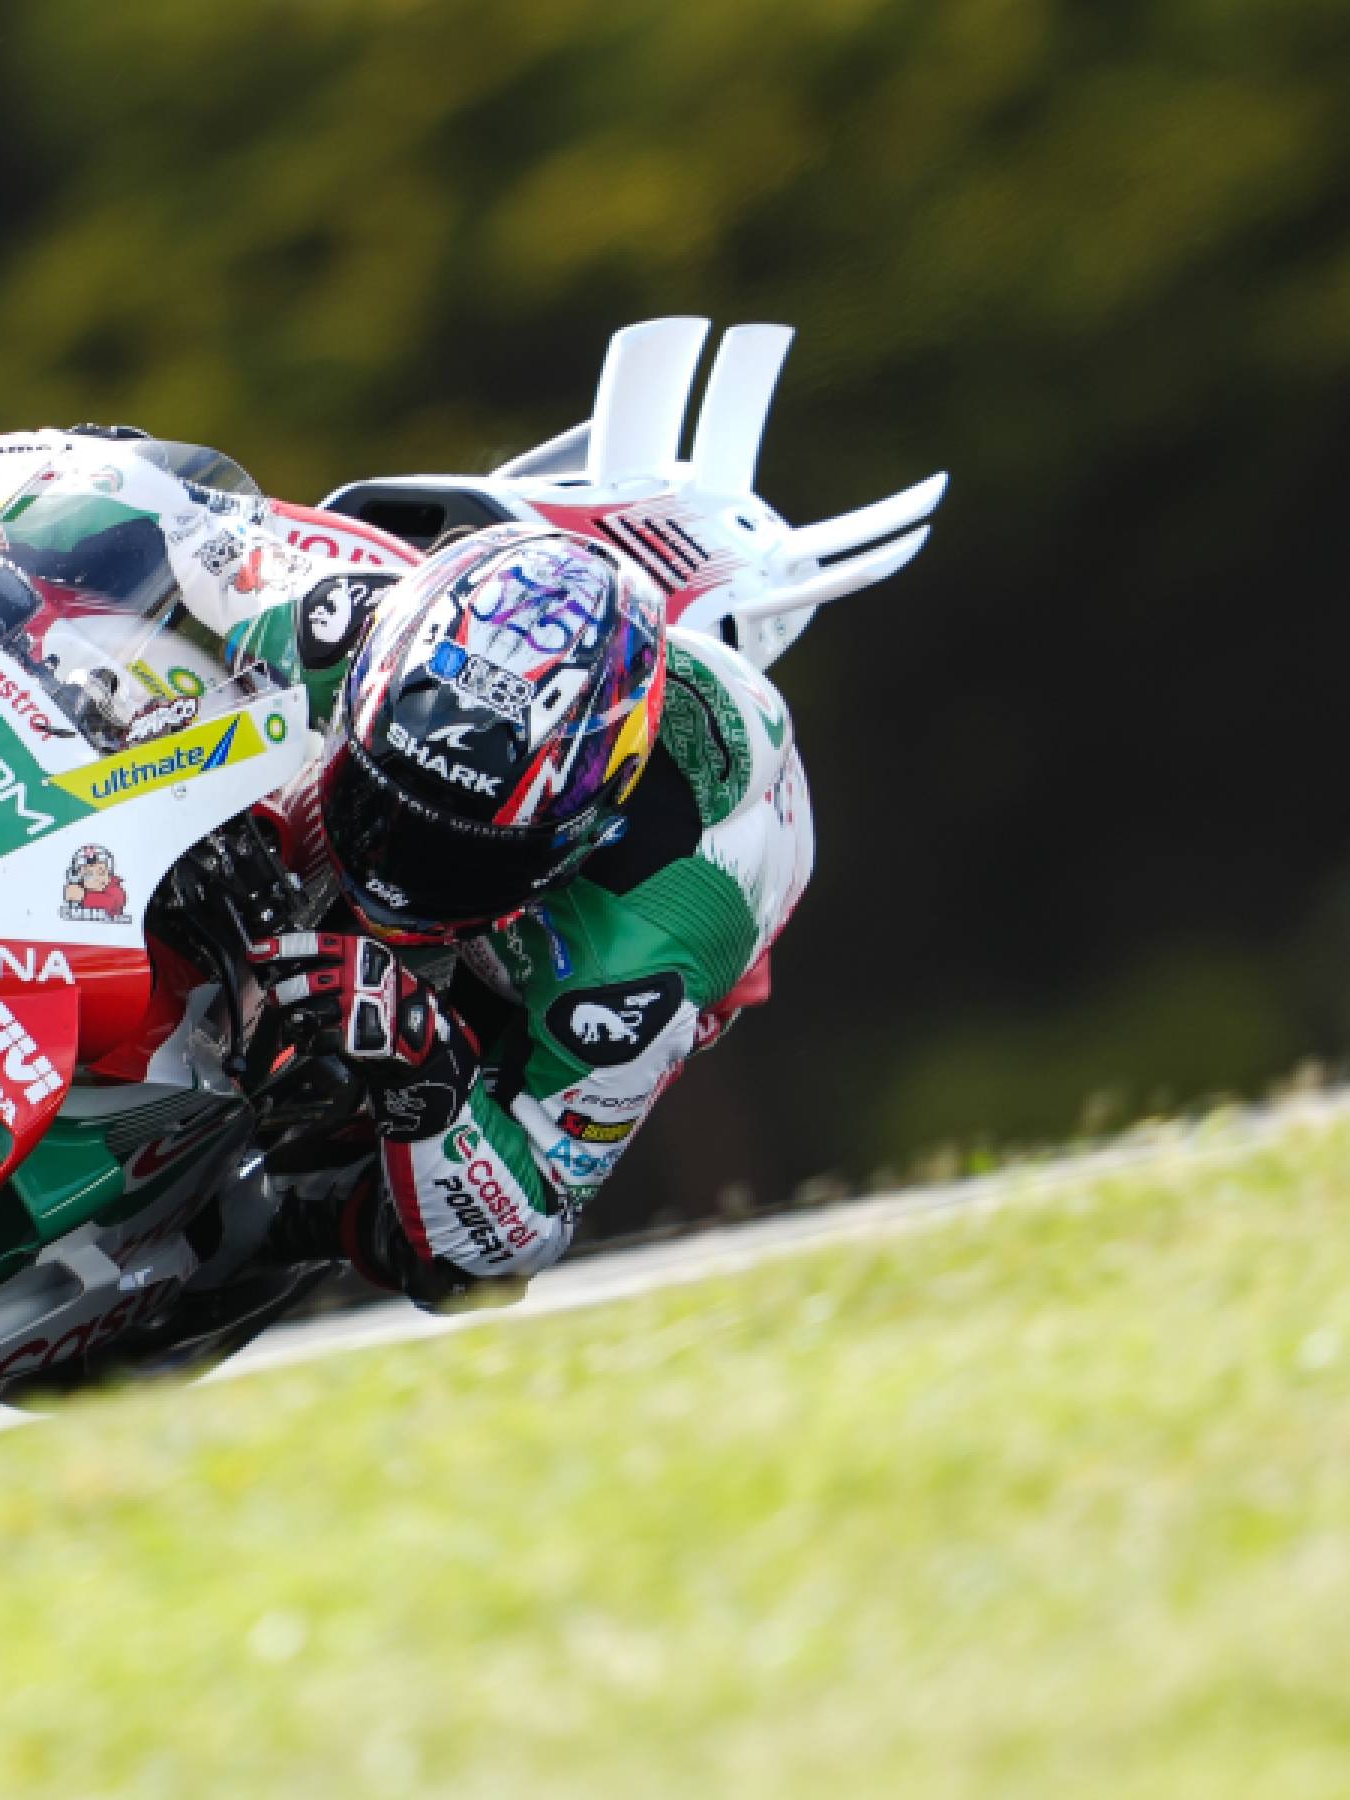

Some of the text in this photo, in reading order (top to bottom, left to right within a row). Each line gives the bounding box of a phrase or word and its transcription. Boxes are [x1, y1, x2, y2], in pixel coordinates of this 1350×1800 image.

[91, 746, 206, 799] ultimate
[386, 722, 503, 798] SHARK
[466, 1159, 538, 1249] Castrol
